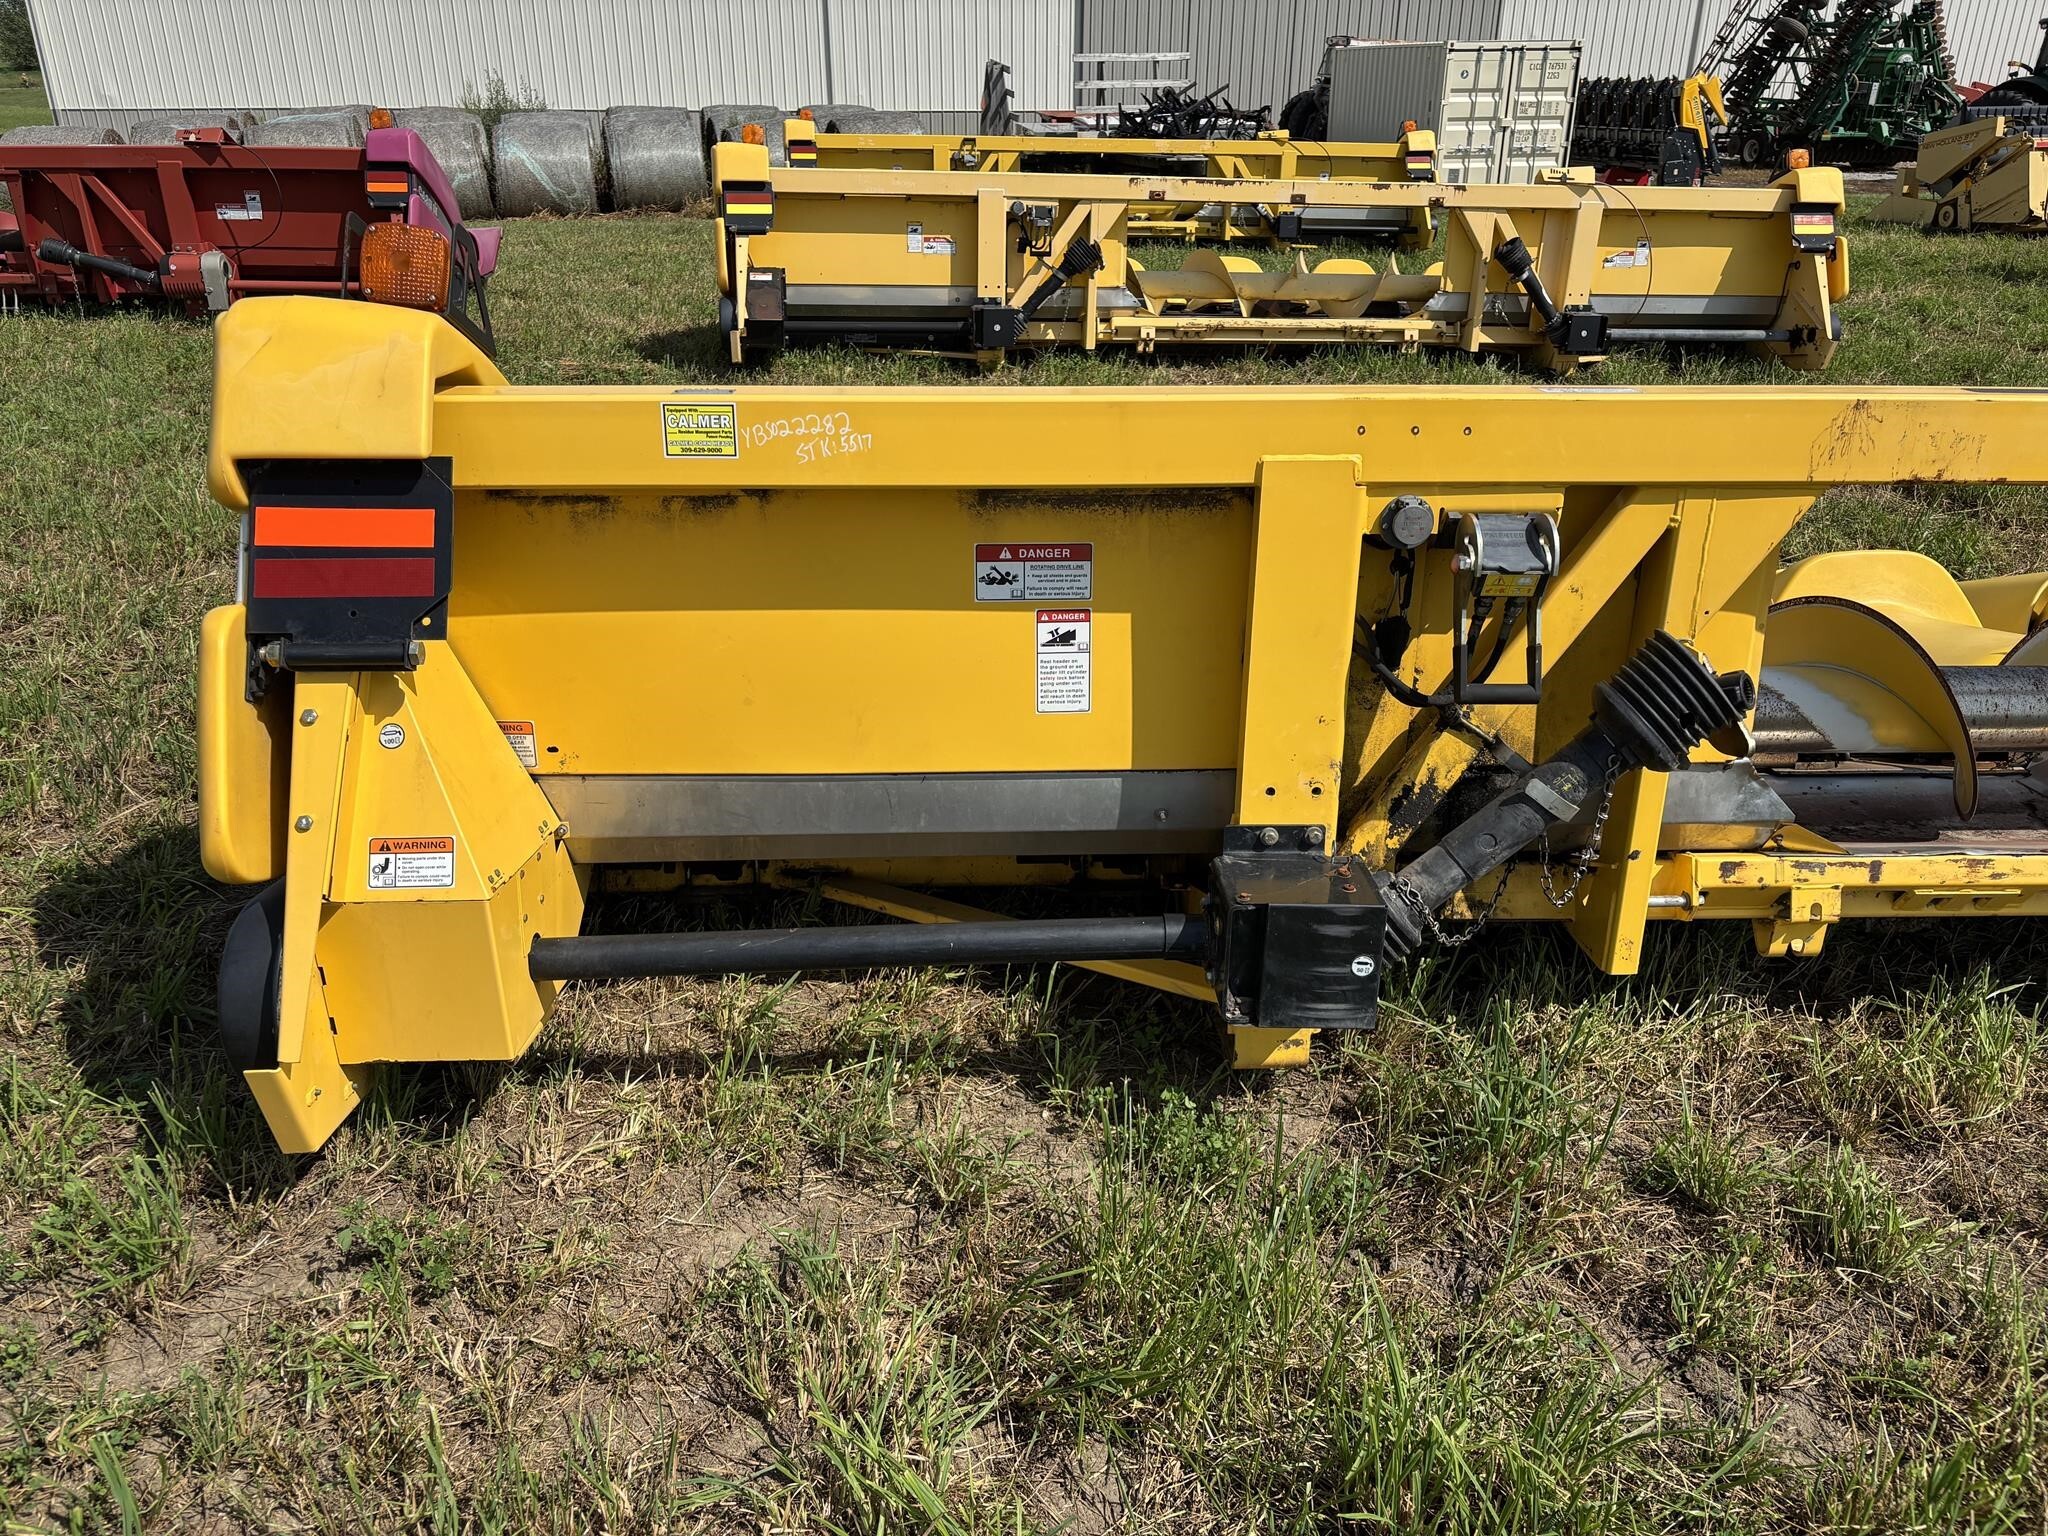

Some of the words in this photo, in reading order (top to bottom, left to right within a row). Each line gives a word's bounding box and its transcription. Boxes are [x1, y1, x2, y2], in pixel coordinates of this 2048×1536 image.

[667, 414, 732, 428] CALMER
[1019, 549, 1070, 558] DANGER
[393, 841, 446, 850] WARNING
